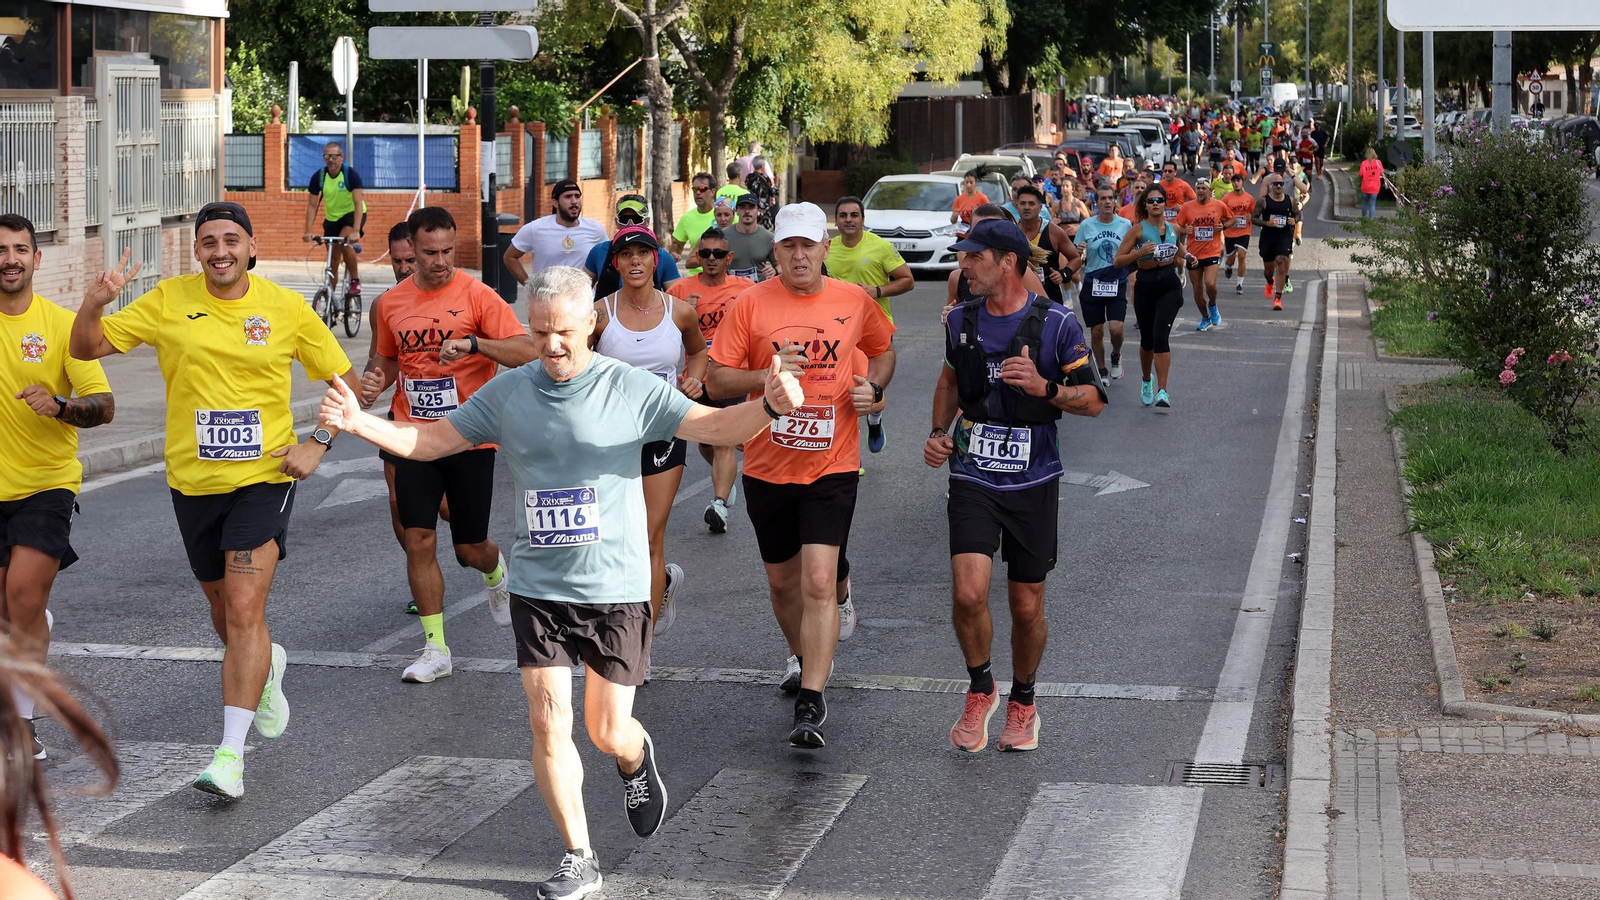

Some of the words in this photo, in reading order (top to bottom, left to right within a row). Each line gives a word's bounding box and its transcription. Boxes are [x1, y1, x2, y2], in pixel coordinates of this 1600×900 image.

[418, 393, 444, 407] 625
[207, 427, 253, 444] 1003
[787, 419, 819, 435] 276
[978, 439, 1019, 458] 1160
[536, 508, 586, 528] 1116
